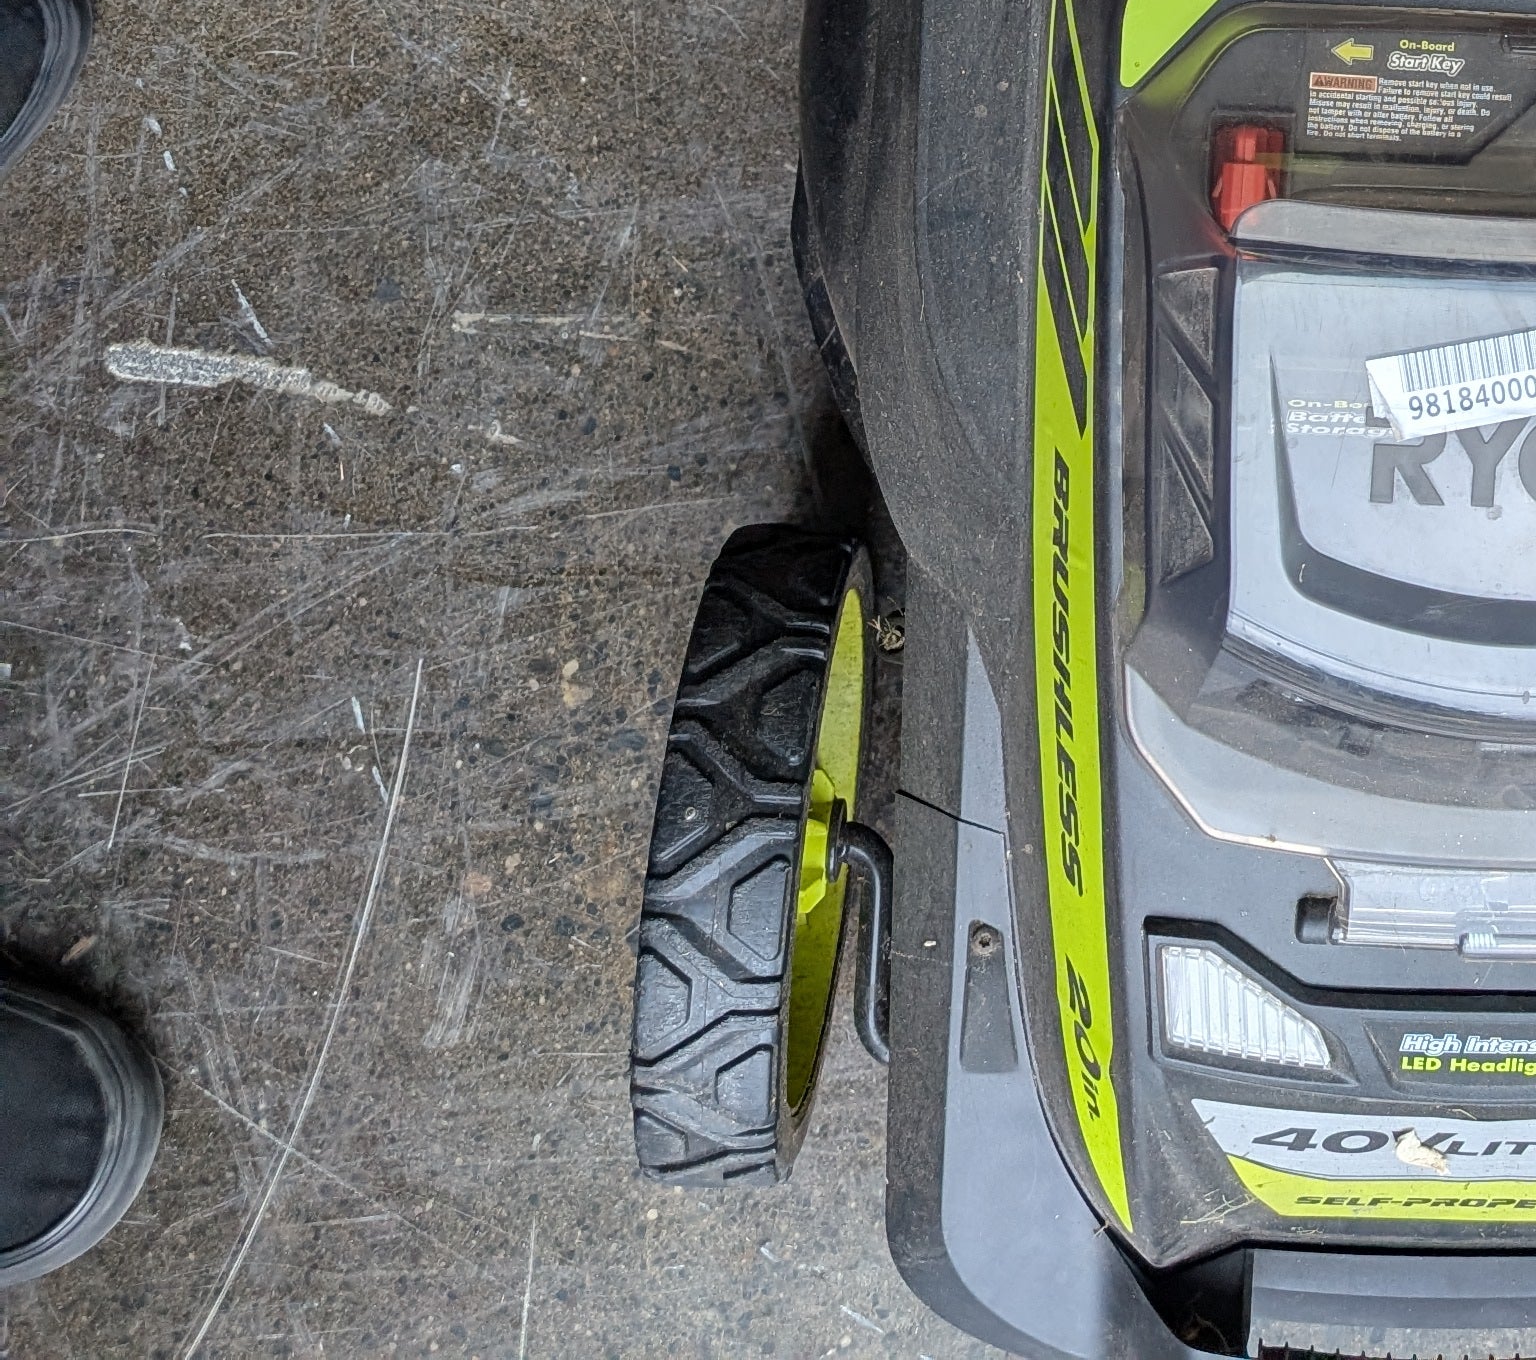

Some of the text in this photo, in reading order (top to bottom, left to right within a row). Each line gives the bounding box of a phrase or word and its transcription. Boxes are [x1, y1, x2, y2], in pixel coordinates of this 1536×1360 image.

[1399, 38, 1454, 52] On-Board
[1387, 51, 1464, 76] Start Key
[1324, 75, 1372, 90] WARNING
[1287, 399, 1372, 409] On-Boa
[1287, 411, 1366, 424] Batte
[1286, 423, 1394, 437] Storag
[1052, 446, 1083, 897] BRUSHLESS
[1401, 1034, 1461, 1055] High
[1402, 1057, 1441, 1070] LED
